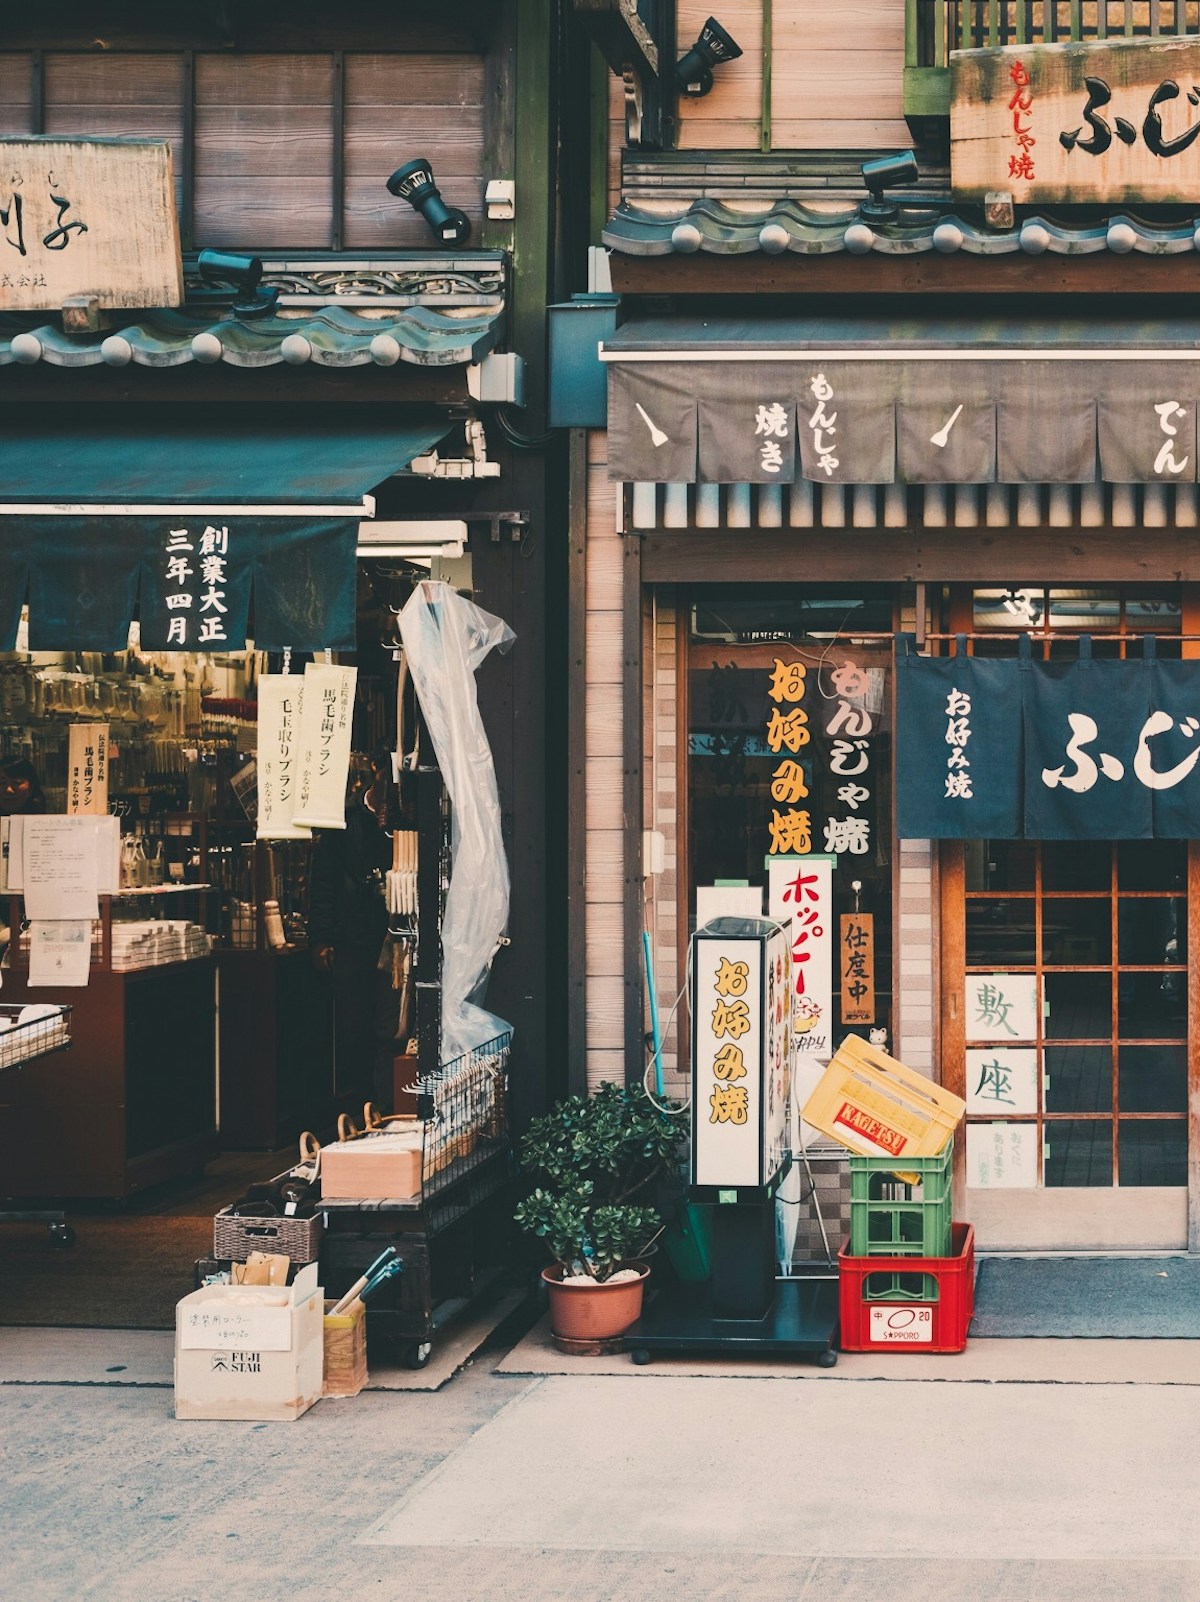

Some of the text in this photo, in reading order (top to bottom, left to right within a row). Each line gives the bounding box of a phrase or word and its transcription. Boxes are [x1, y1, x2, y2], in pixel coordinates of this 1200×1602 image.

[1008, 60, 1035, 181] もんじゃ焼
[754, 402, 789, 473] 焼き
[809, 373, 840, 477] もんじゃ
[1153, 400, 1189, 474] でん
[165, 528, 195, 645] 三年四月
[198, 526, 229, 643] 創業大正
[278, 698, 293, 802] 毛玉取りブラシ
[319, 688, 337, 776] 馬毛歯ブラシ
[766, 657, 812, 855] お好み焼
[824, 661, 873, 855] もんじゃ焼
[944, 688, 973, 799] お好み焼
[782, 868, 824, 995] ホッピー
[844, 923, 869, 1006] 仕度中
[709, 957, 750, 1125] お好み焼
[840, 1103, 906, 1150] KAGETSU
[231, 1352, 260, 1362] FUJI
[231, 1363, 261, 1372] STAR
[919, 1311, 930, 1321] 20
